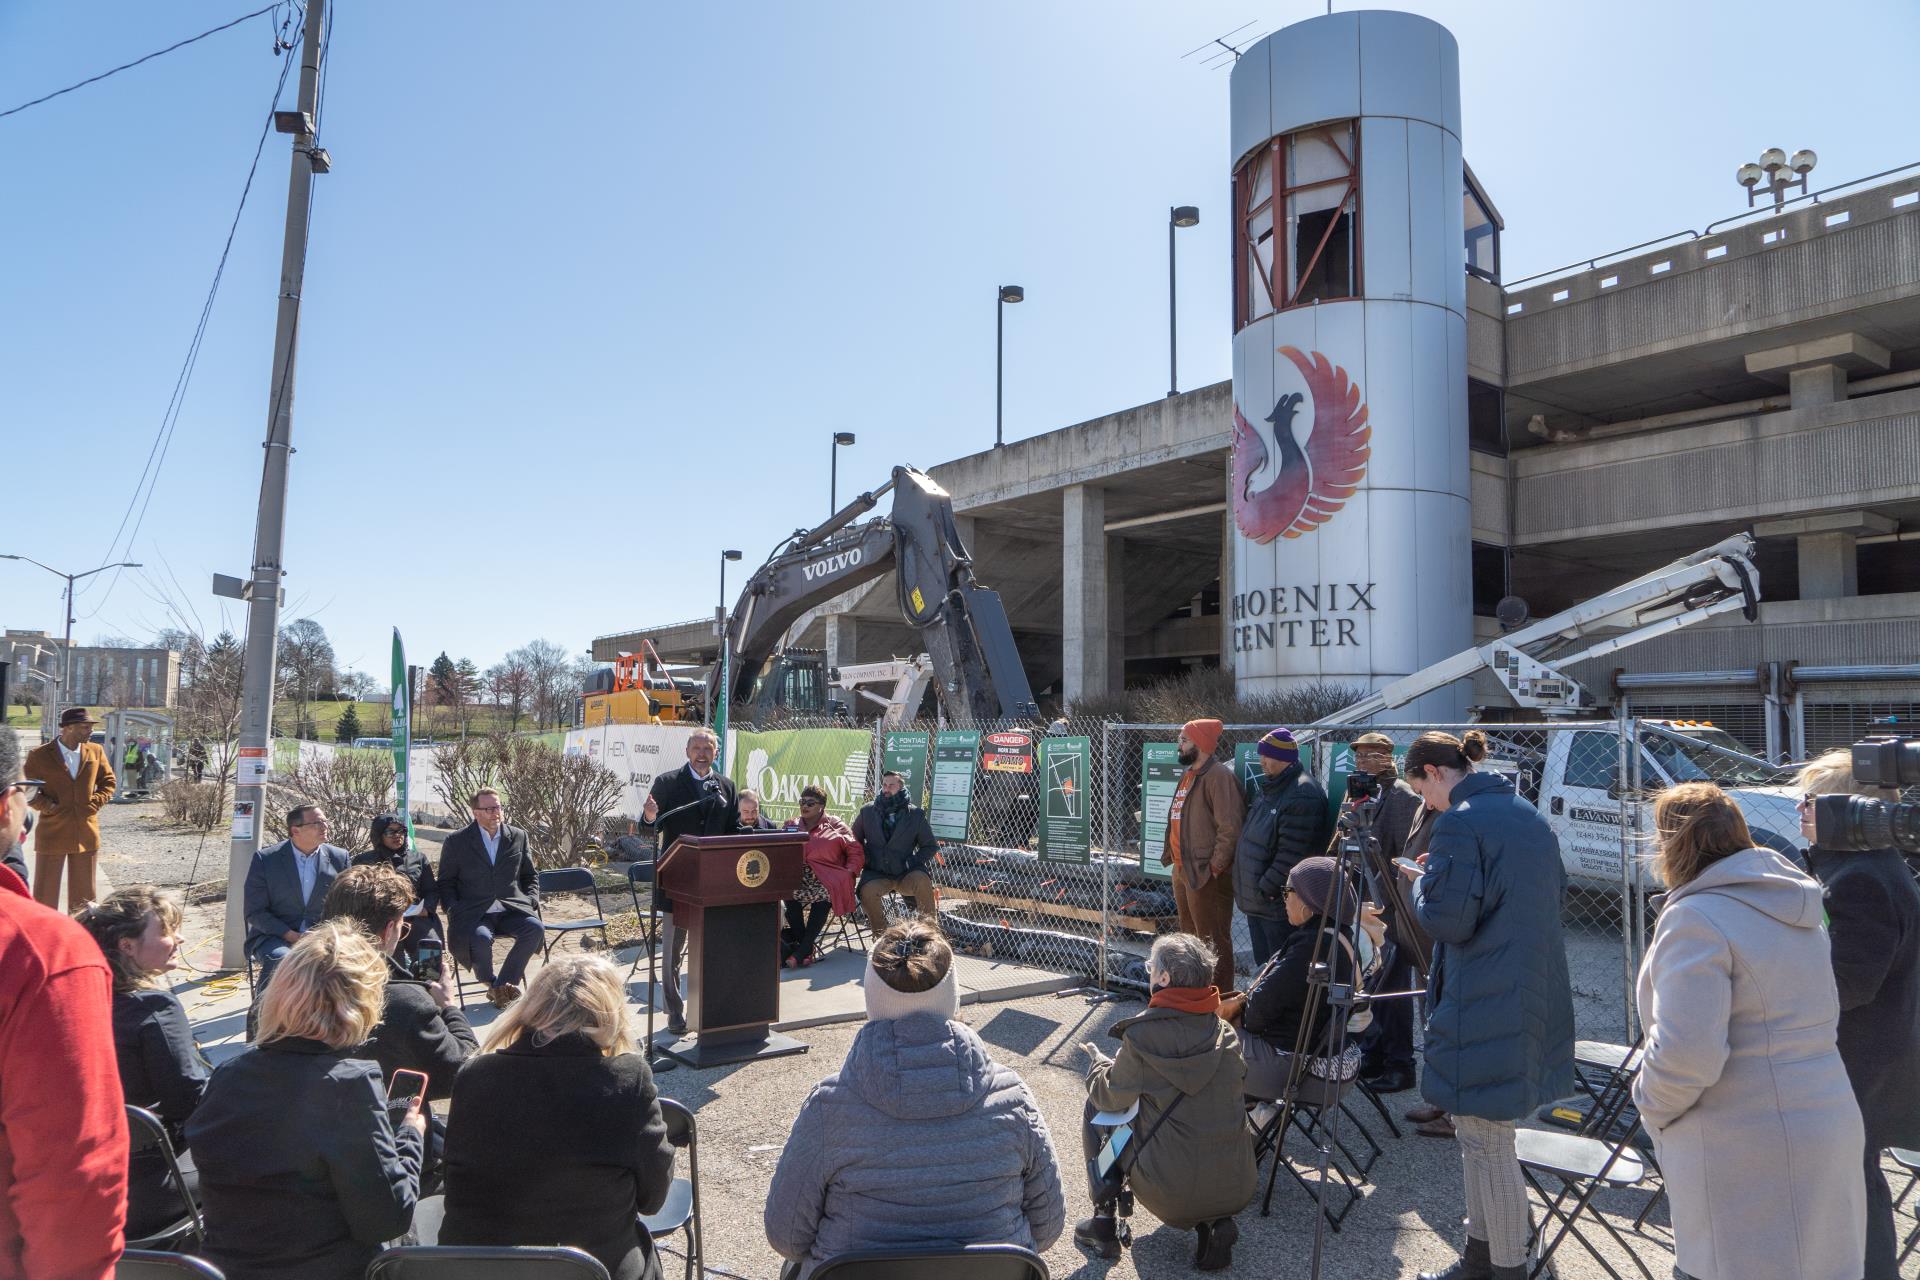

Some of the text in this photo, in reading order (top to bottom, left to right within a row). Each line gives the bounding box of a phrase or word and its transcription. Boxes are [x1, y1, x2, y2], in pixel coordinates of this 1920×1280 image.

[803, 548, 862, 581] VOLVO
[1233, 618, 1361, 653] CENTER
[993, 736, 1024, 744] DANGER
[1574, 809, 1634, 826] LAVANWY
